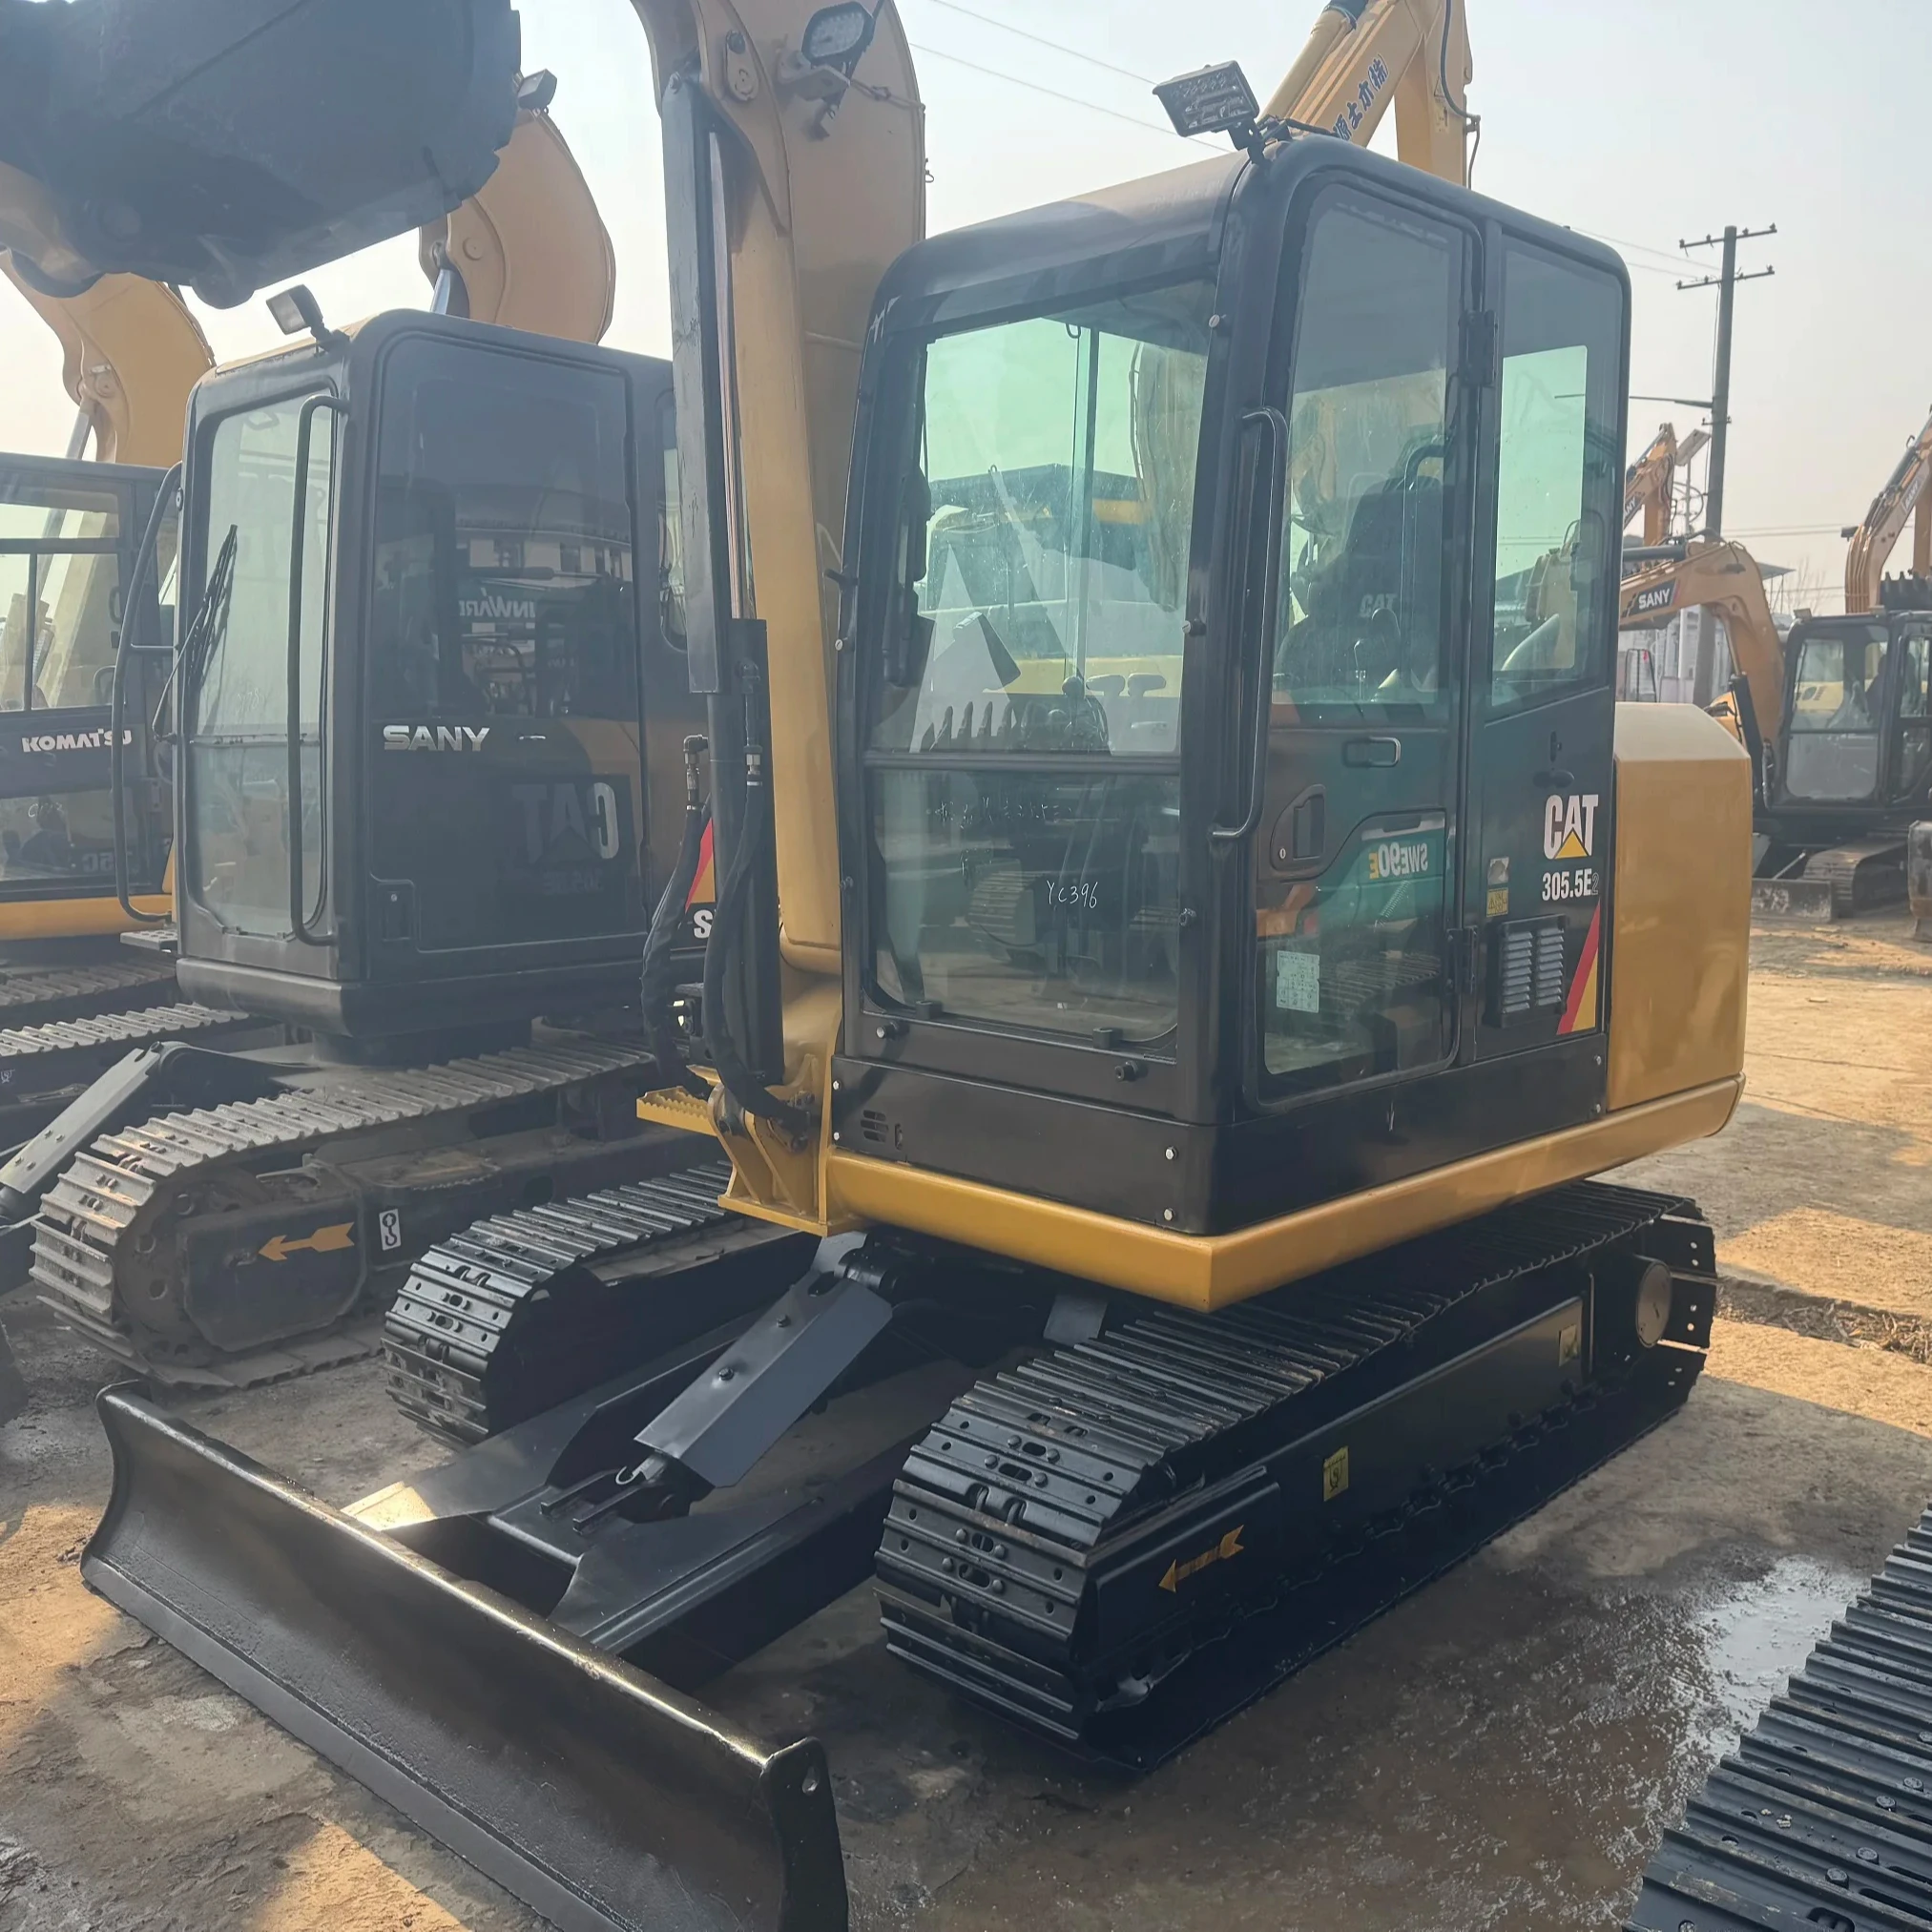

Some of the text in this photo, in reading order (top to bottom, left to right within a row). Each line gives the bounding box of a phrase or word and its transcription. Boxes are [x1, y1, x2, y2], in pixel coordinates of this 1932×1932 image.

[1360, 592, 1398, 618] CAT
[1638, 589, 1671, 610] SANY
[383, 725, 490, 751] SANY
[1544, 794, 1599, 859] CAT
[1047, 881, 1098, 909] YC396
